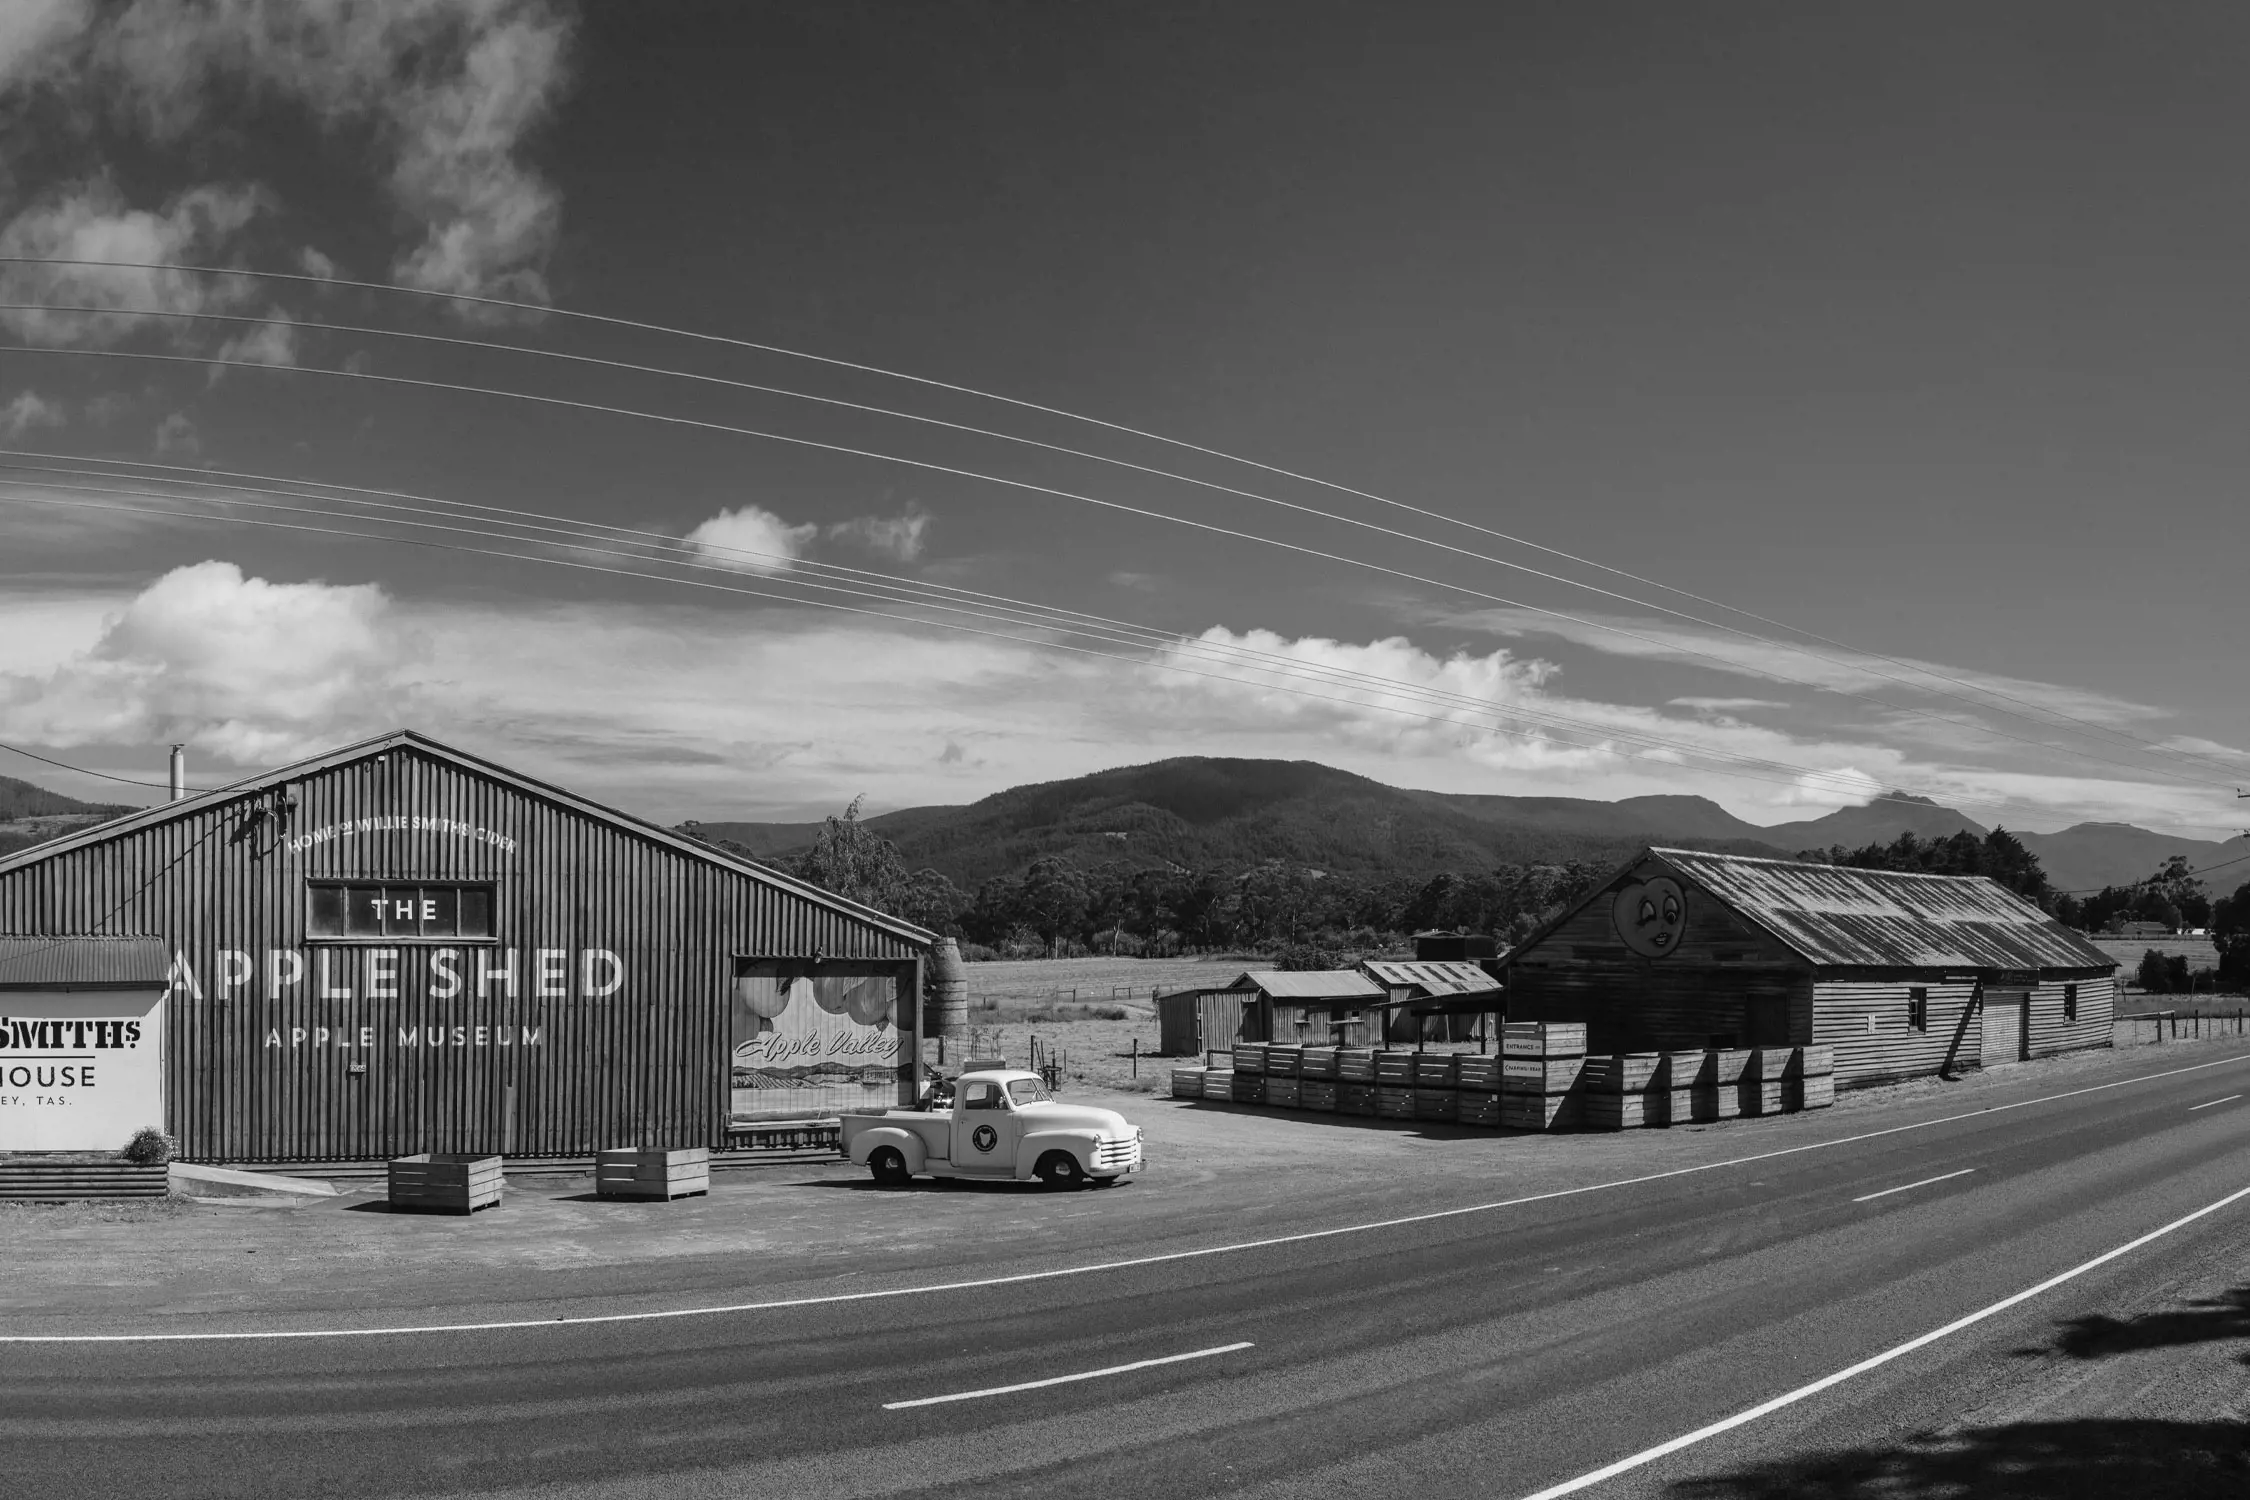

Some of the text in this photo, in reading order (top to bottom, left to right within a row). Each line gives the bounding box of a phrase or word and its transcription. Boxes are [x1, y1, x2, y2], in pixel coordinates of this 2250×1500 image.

[287, 825, 336, 853] HOME
[356, 816, 408, 831] WILLIE
[412, 816, 470, 836] SMITHS
[474, 827, 517, 854] CIDER
[371, 899, 436, 920] THE
[163, 948, 624, 1000] APPLE SHED
[265, 1025, 541, 1047] APPLE MUSEUM
[735, 1028, 904, 1062] Apple Valley
[0, 1066, 96, 1087] OUSE
[37, 1096, 72, 1106] TAS.
